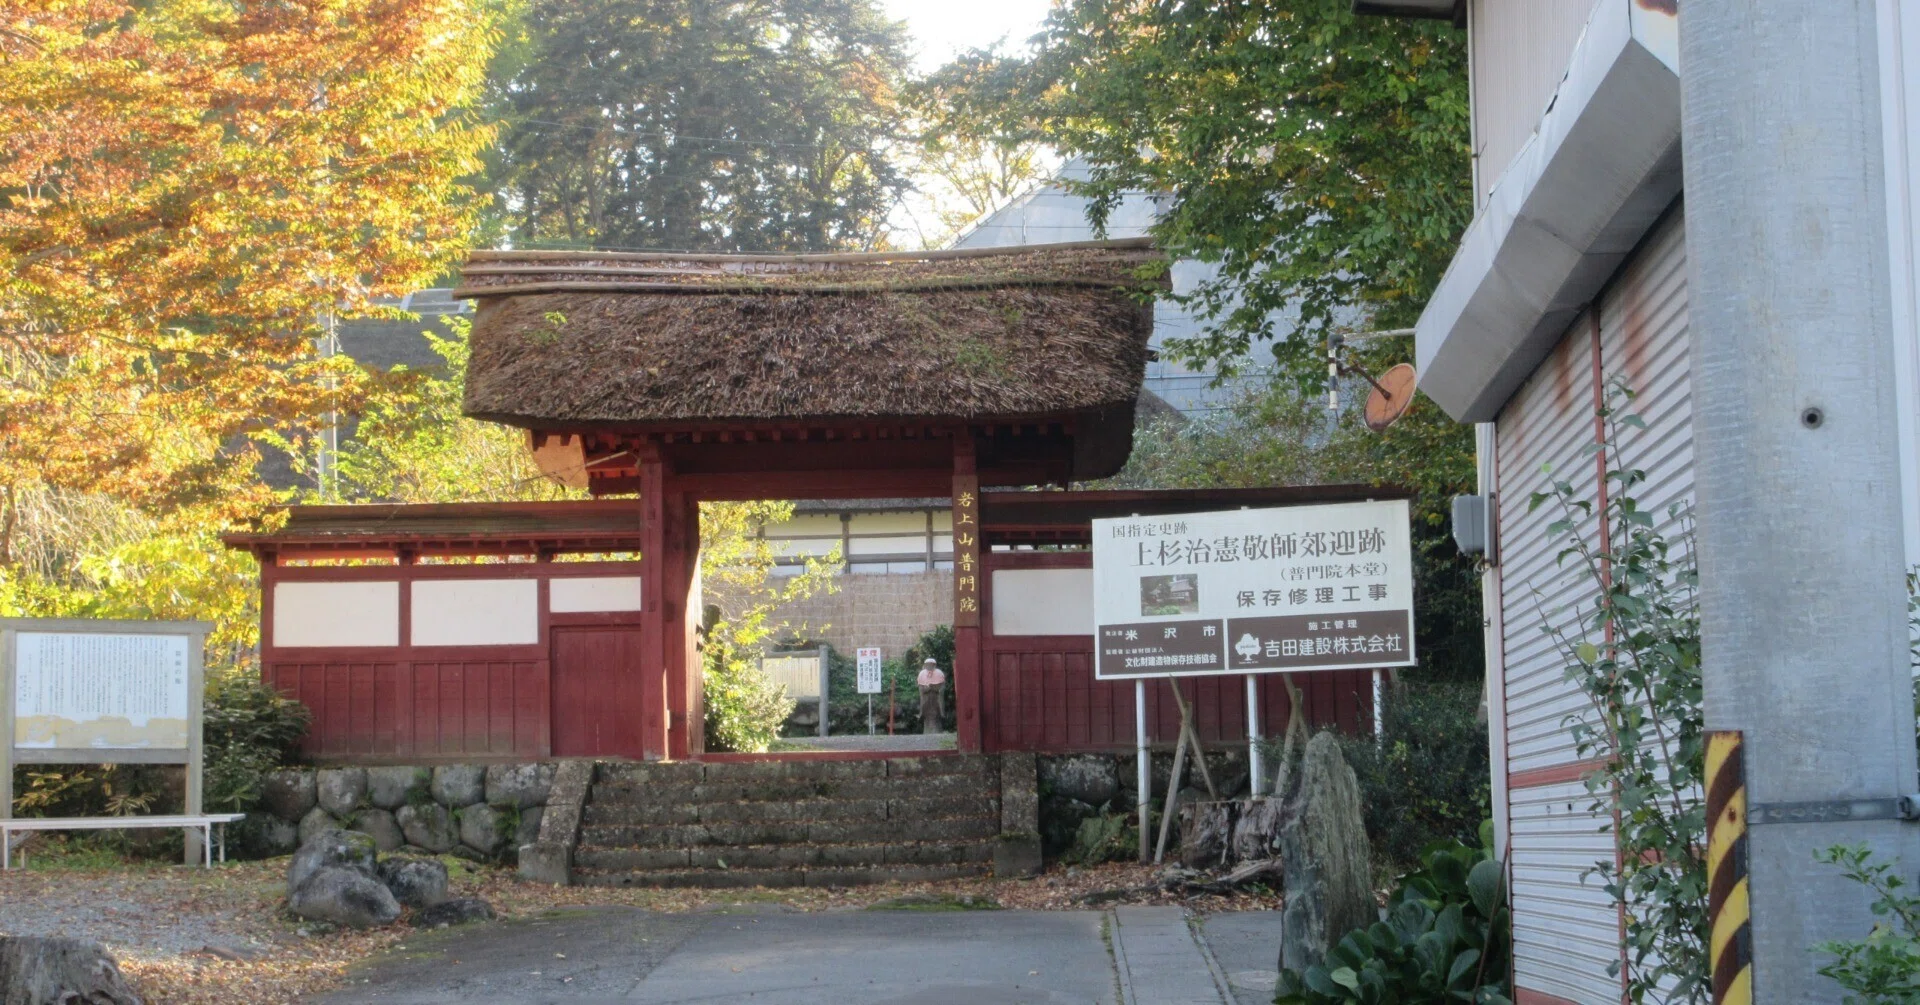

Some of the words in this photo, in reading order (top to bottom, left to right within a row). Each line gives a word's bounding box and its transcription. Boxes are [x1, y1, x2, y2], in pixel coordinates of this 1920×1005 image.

[1112, 522, 1188, 538] 国指定史跡
[957, 491, 976, 612] 岩上山普門院
[1130, 527, 1386, 566] 上杉治憲敬師郊迎跡
[1236, 584, 1388, 607] 保存修理工事
[1125, 625, 1216, 641] 米沢市
[1308, 619, 1358, 631] 施工管理
[1264, 633, 1403, 657] 吉田建設株式会社
[1125, 653, 1217, 668] 文化財建造物保存技術協会
